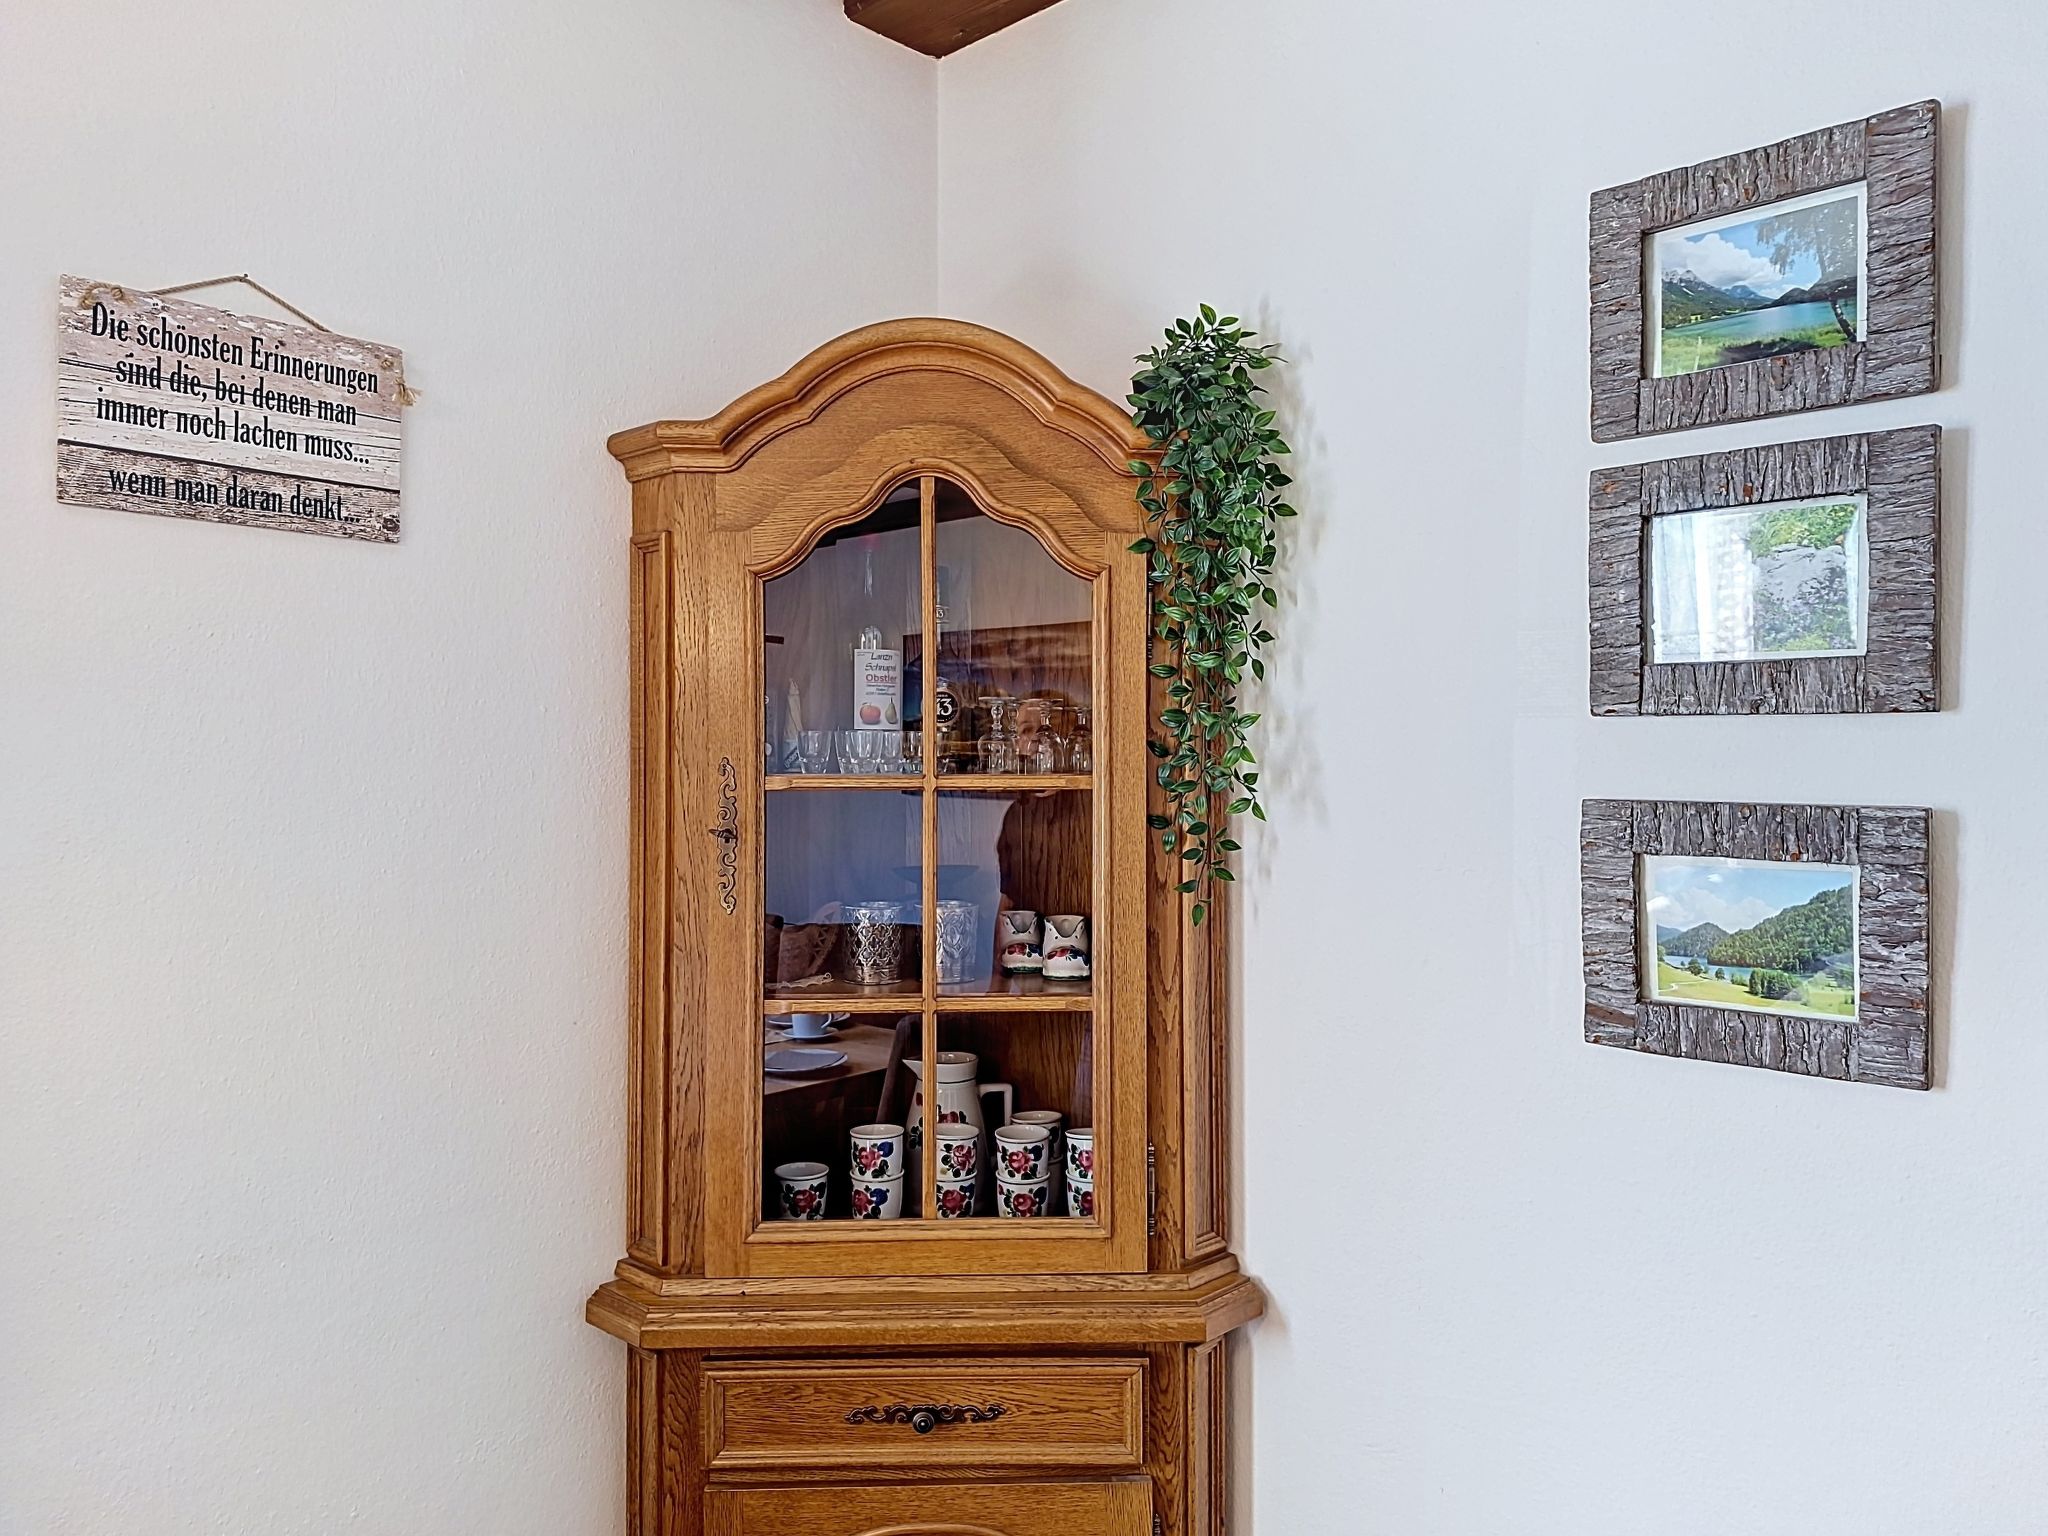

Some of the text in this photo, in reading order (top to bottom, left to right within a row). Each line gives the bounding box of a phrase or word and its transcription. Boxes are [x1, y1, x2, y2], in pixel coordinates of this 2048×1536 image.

[91, 302, 379, 395] Die schönsten Erinnerungen
[96, 387, 371, 466] immer noch lachen muss...
[115, 353, 358, 427] sind die, bei denen man
[108, 469, 361, 525] wenn man daran denkt...
[866, 674, 898, 682] Obstler
